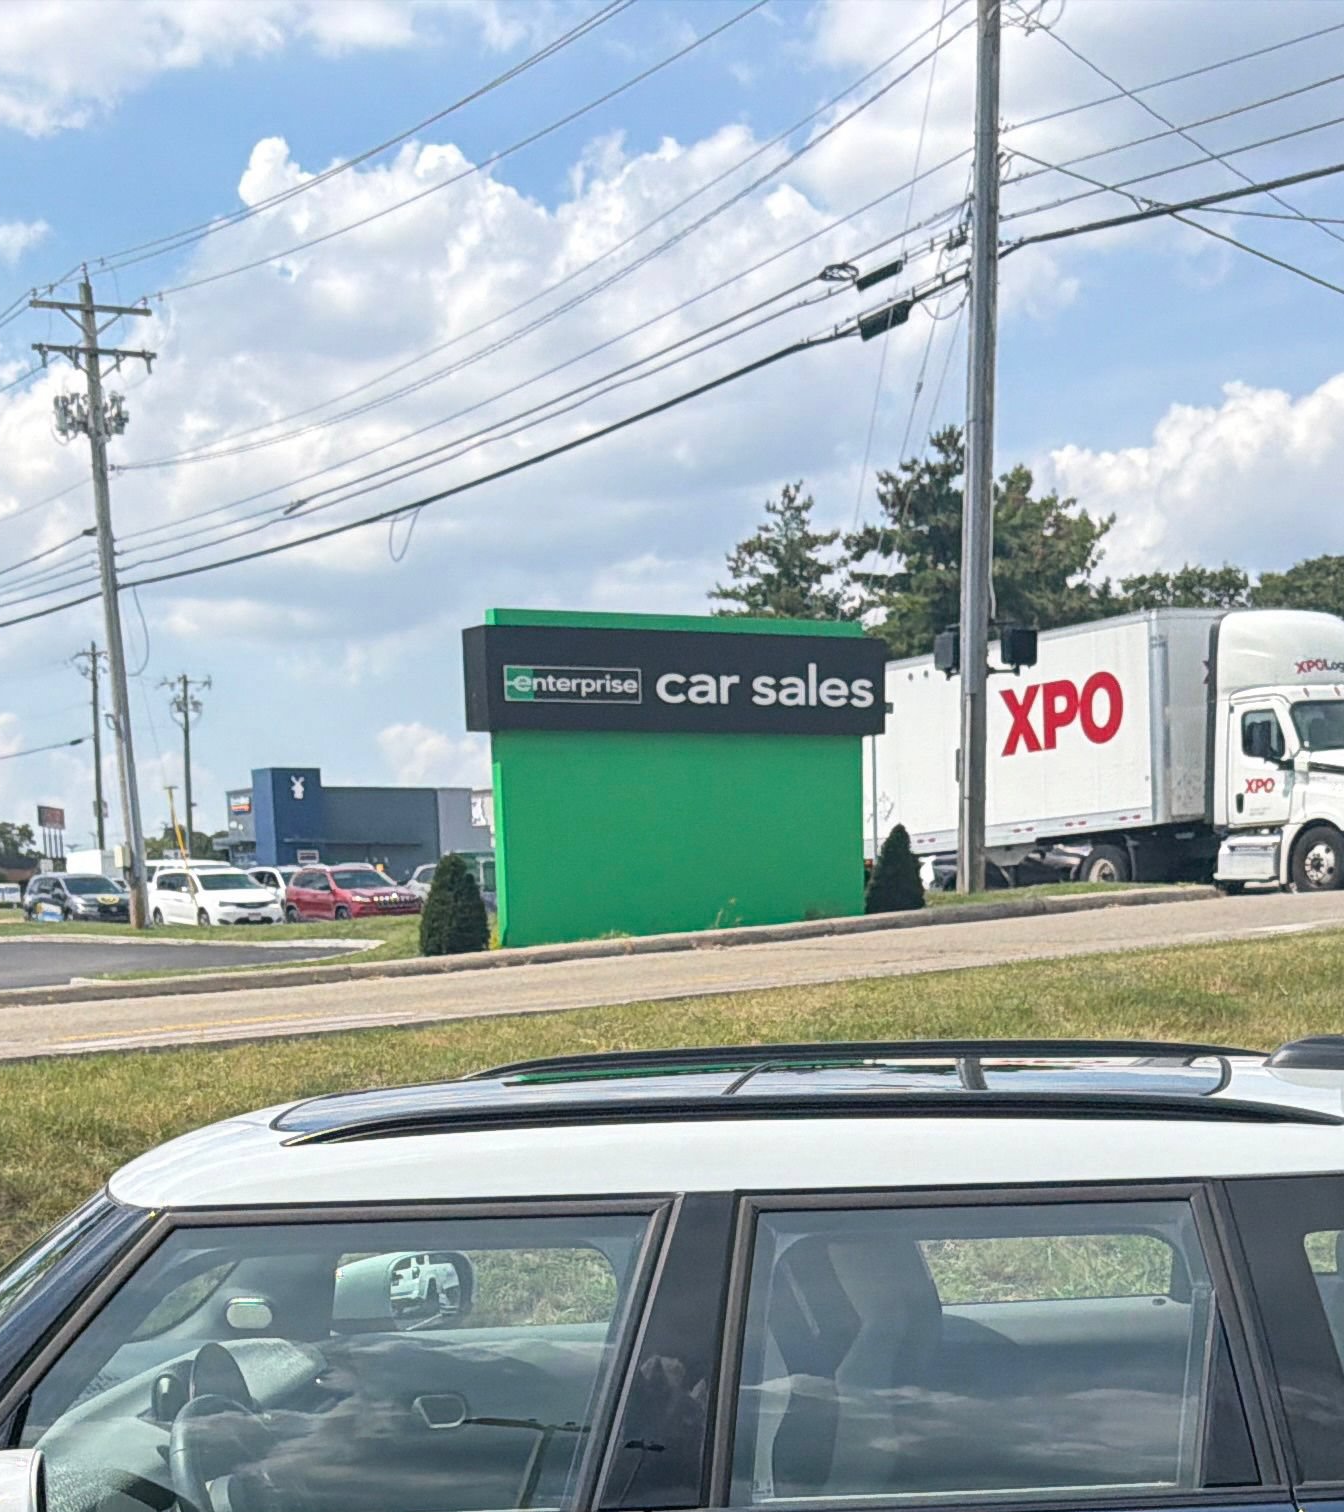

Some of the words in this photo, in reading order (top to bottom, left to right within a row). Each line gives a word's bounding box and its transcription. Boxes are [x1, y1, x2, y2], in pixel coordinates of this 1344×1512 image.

[512, 673, 638, 698] enterprise
[656, 672, 740, 705] car
[751, 663, 875, 708] sales
[999, 672, 1124, 757] XPO
[1245, 778, 1275, 793] XPO
